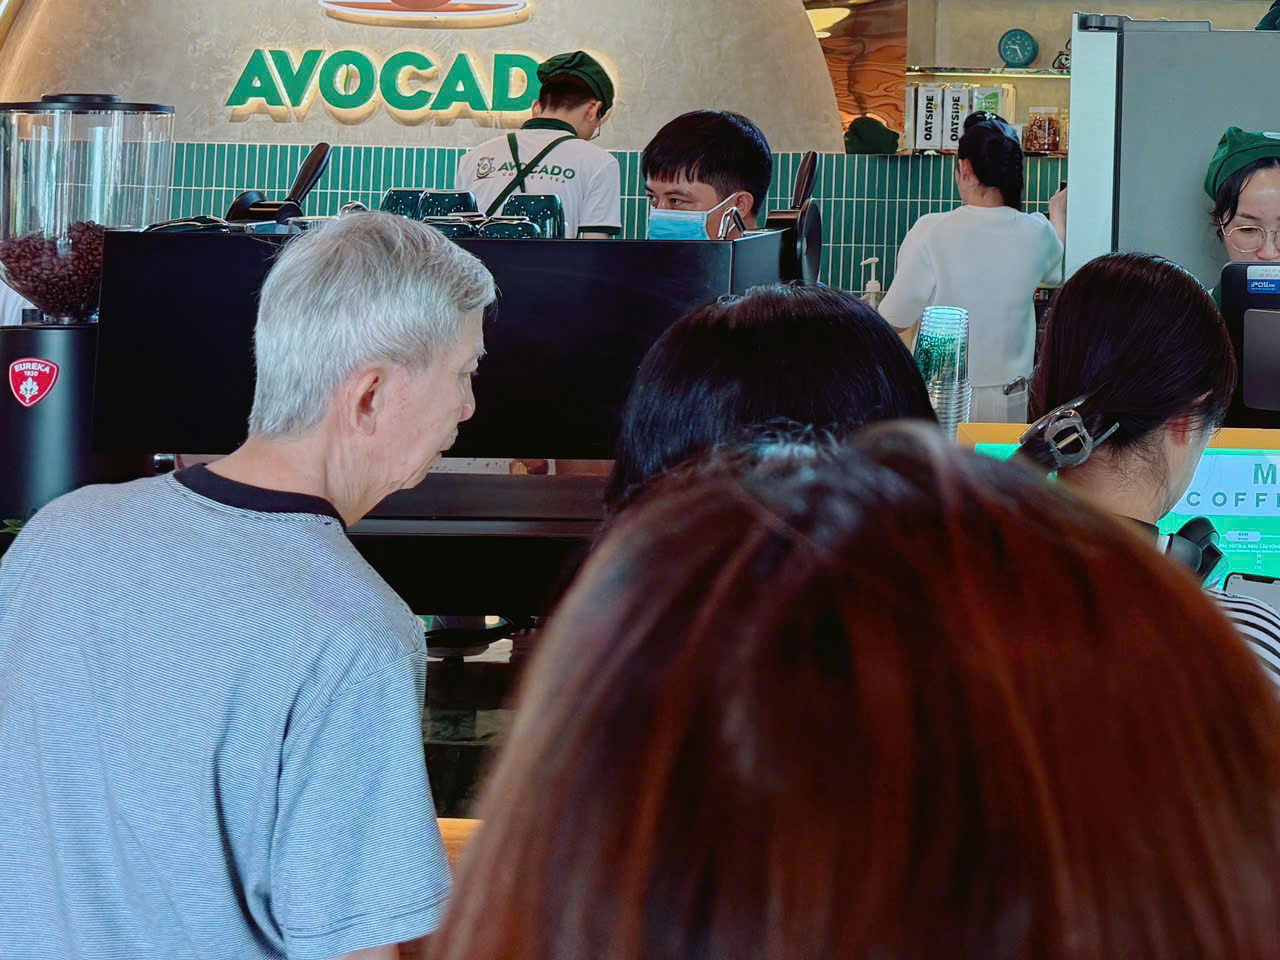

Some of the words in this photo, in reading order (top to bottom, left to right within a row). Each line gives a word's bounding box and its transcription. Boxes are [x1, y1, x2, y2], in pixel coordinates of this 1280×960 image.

[226, 48, 542, 113] AVOCAD
[924, 95, 935, 141] OATSIDE
[950, 95, 961, 142] OATSIDE
[14, 362, 50, 375] EUREKA
